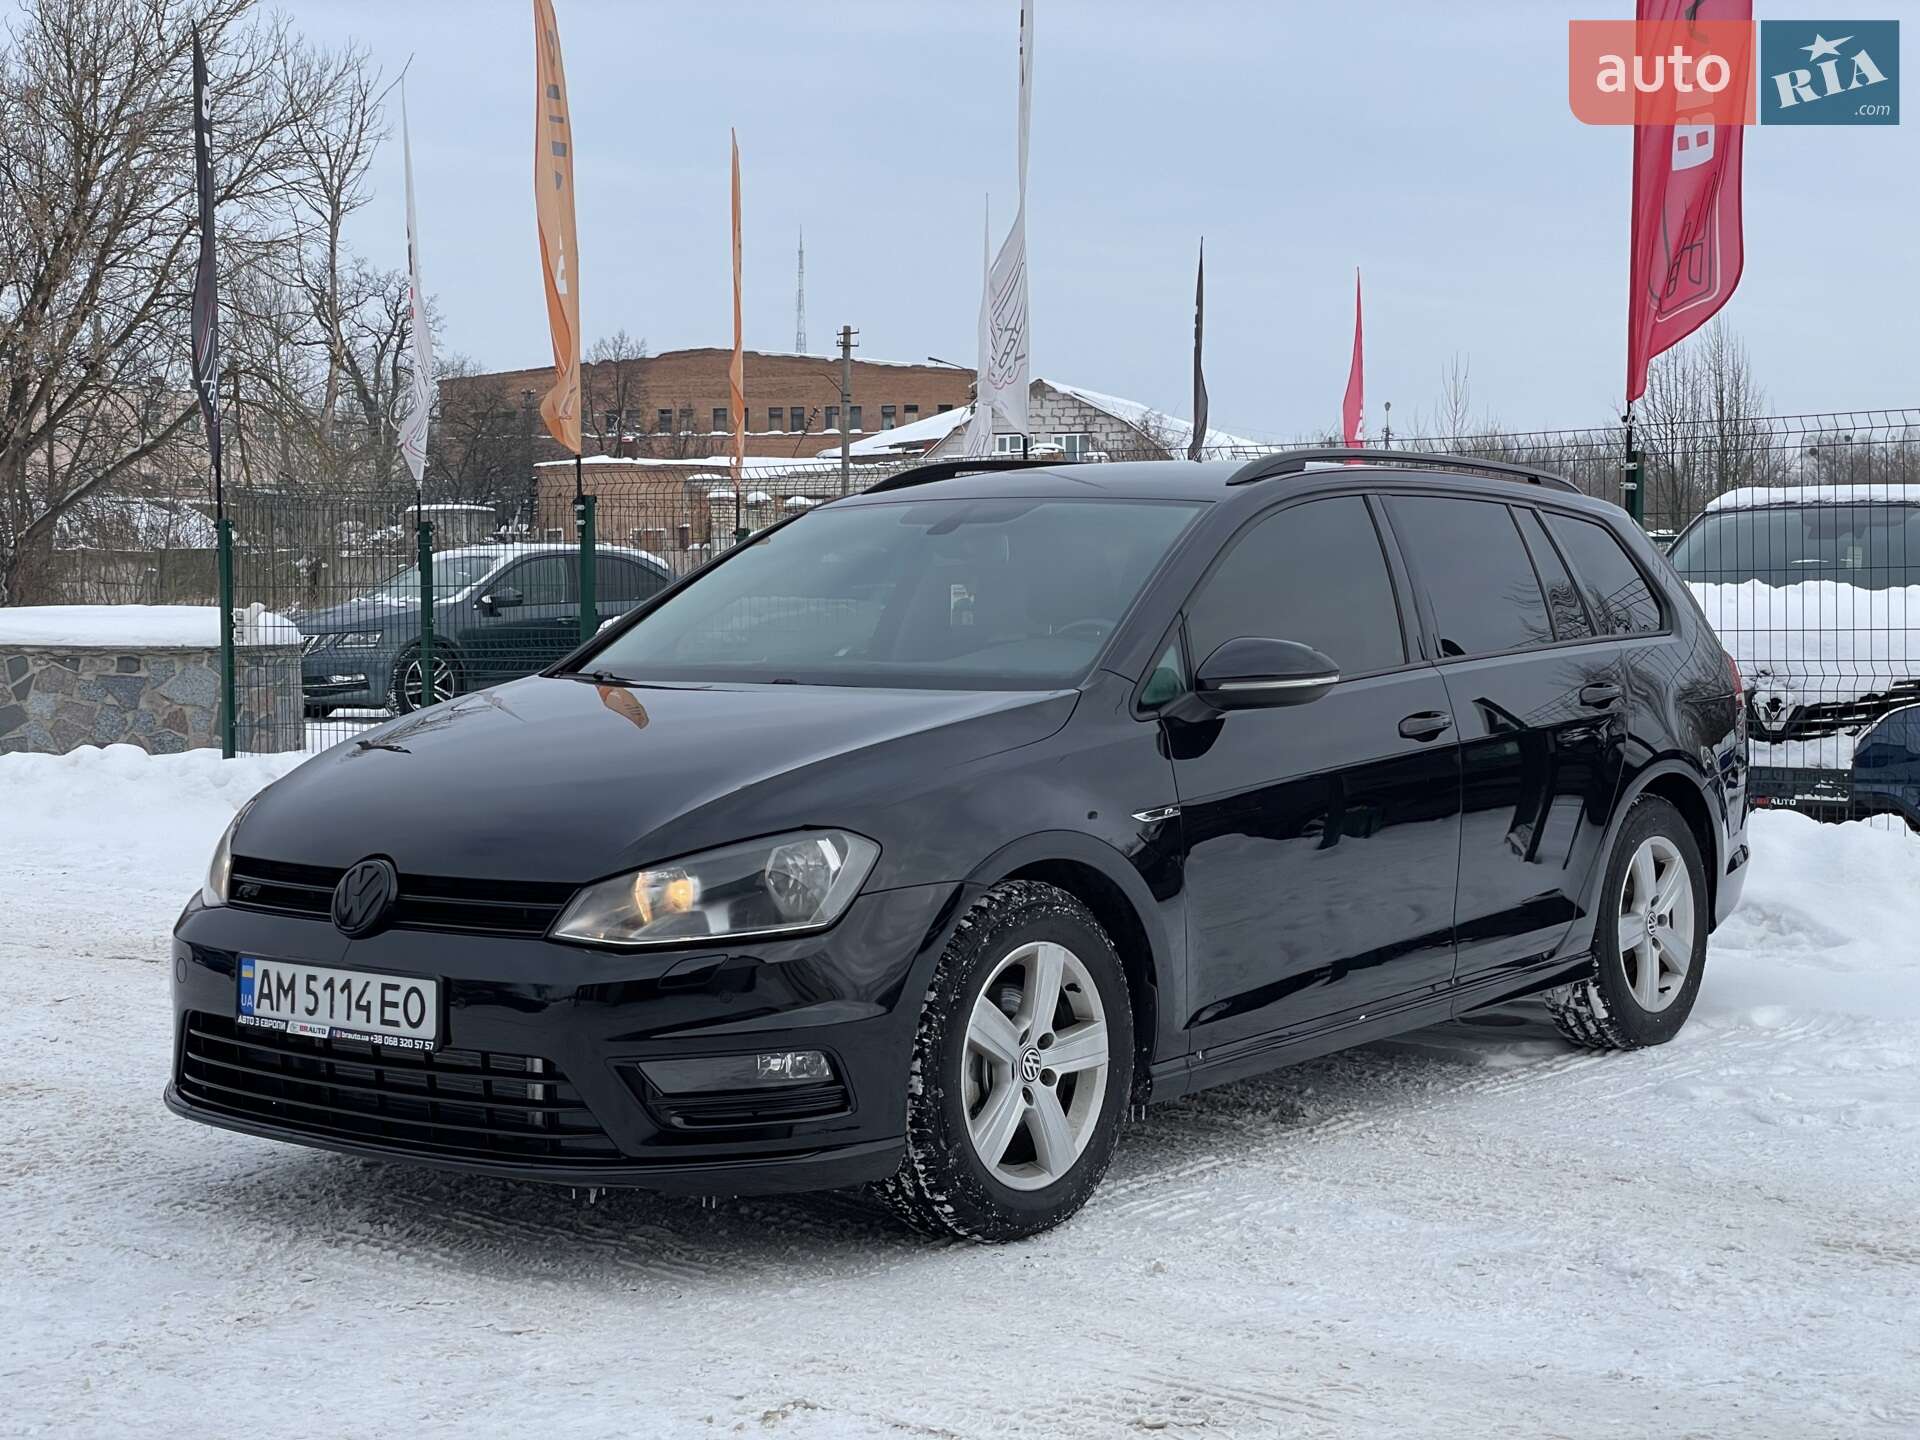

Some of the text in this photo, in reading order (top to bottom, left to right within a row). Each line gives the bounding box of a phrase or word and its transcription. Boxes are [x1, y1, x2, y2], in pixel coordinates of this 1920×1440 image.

[240, 993, 254, 1008] UA
[237, 1014, 255, 1026] АВТО
[299, 1024, 327, 1035] BRAUTO
[341, 1031, 370, 1042] brauto.ua
[383, 1036, 398, 1046] 068
[399, 1038, 413, 1048] 320
[414, 1040, 424, 1049] 57
[424, 1041, 434, 1050] 57
